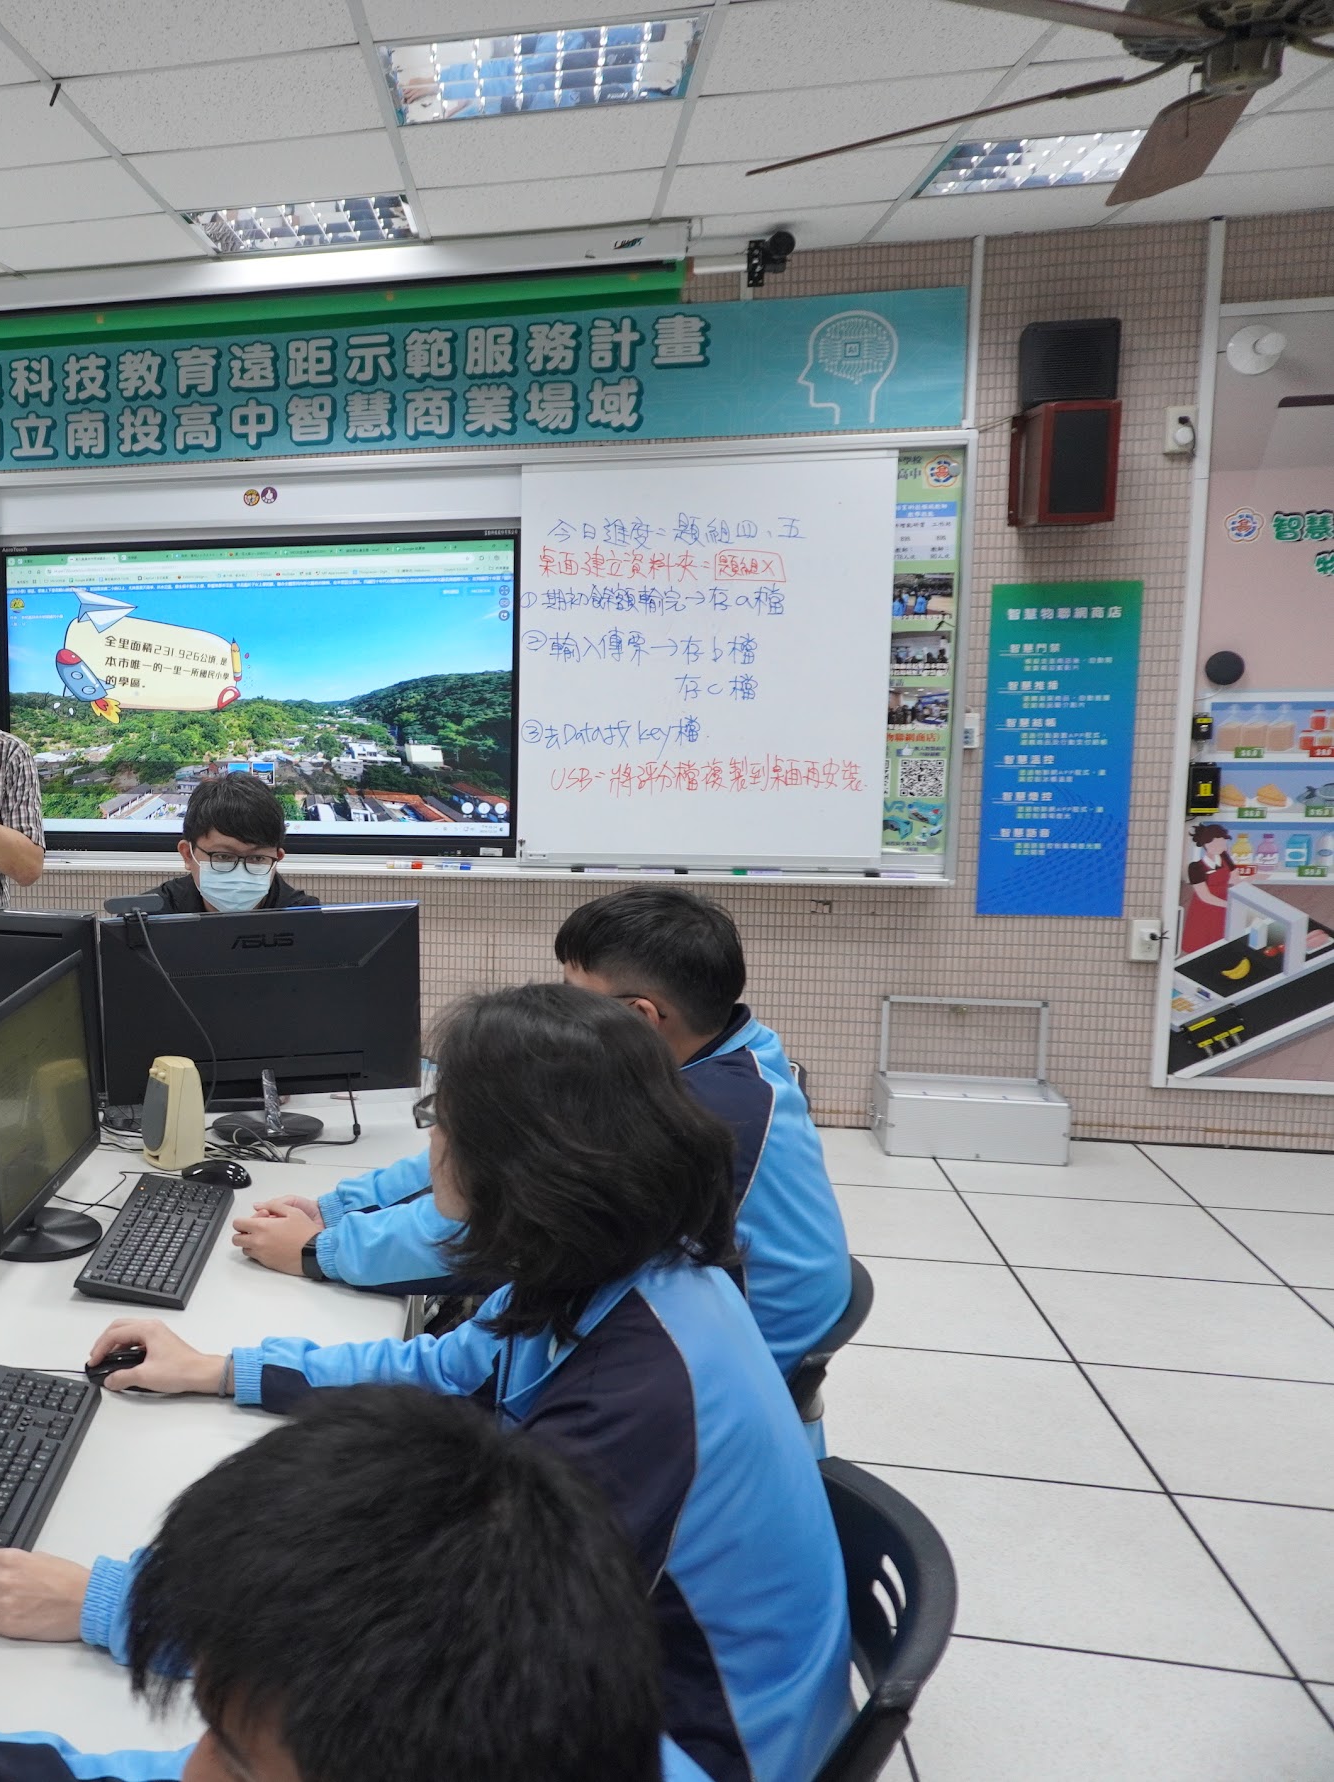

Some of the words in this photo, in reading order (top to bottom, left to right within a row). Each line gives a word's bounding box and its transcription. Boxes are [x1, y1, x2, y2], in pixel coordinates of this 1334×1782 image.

[1273, 511, 1334, 541] 智慧
[1007, 606, 1123, 620] 智慧物聯網商店
[231, 932, 295, 950] ASUS
